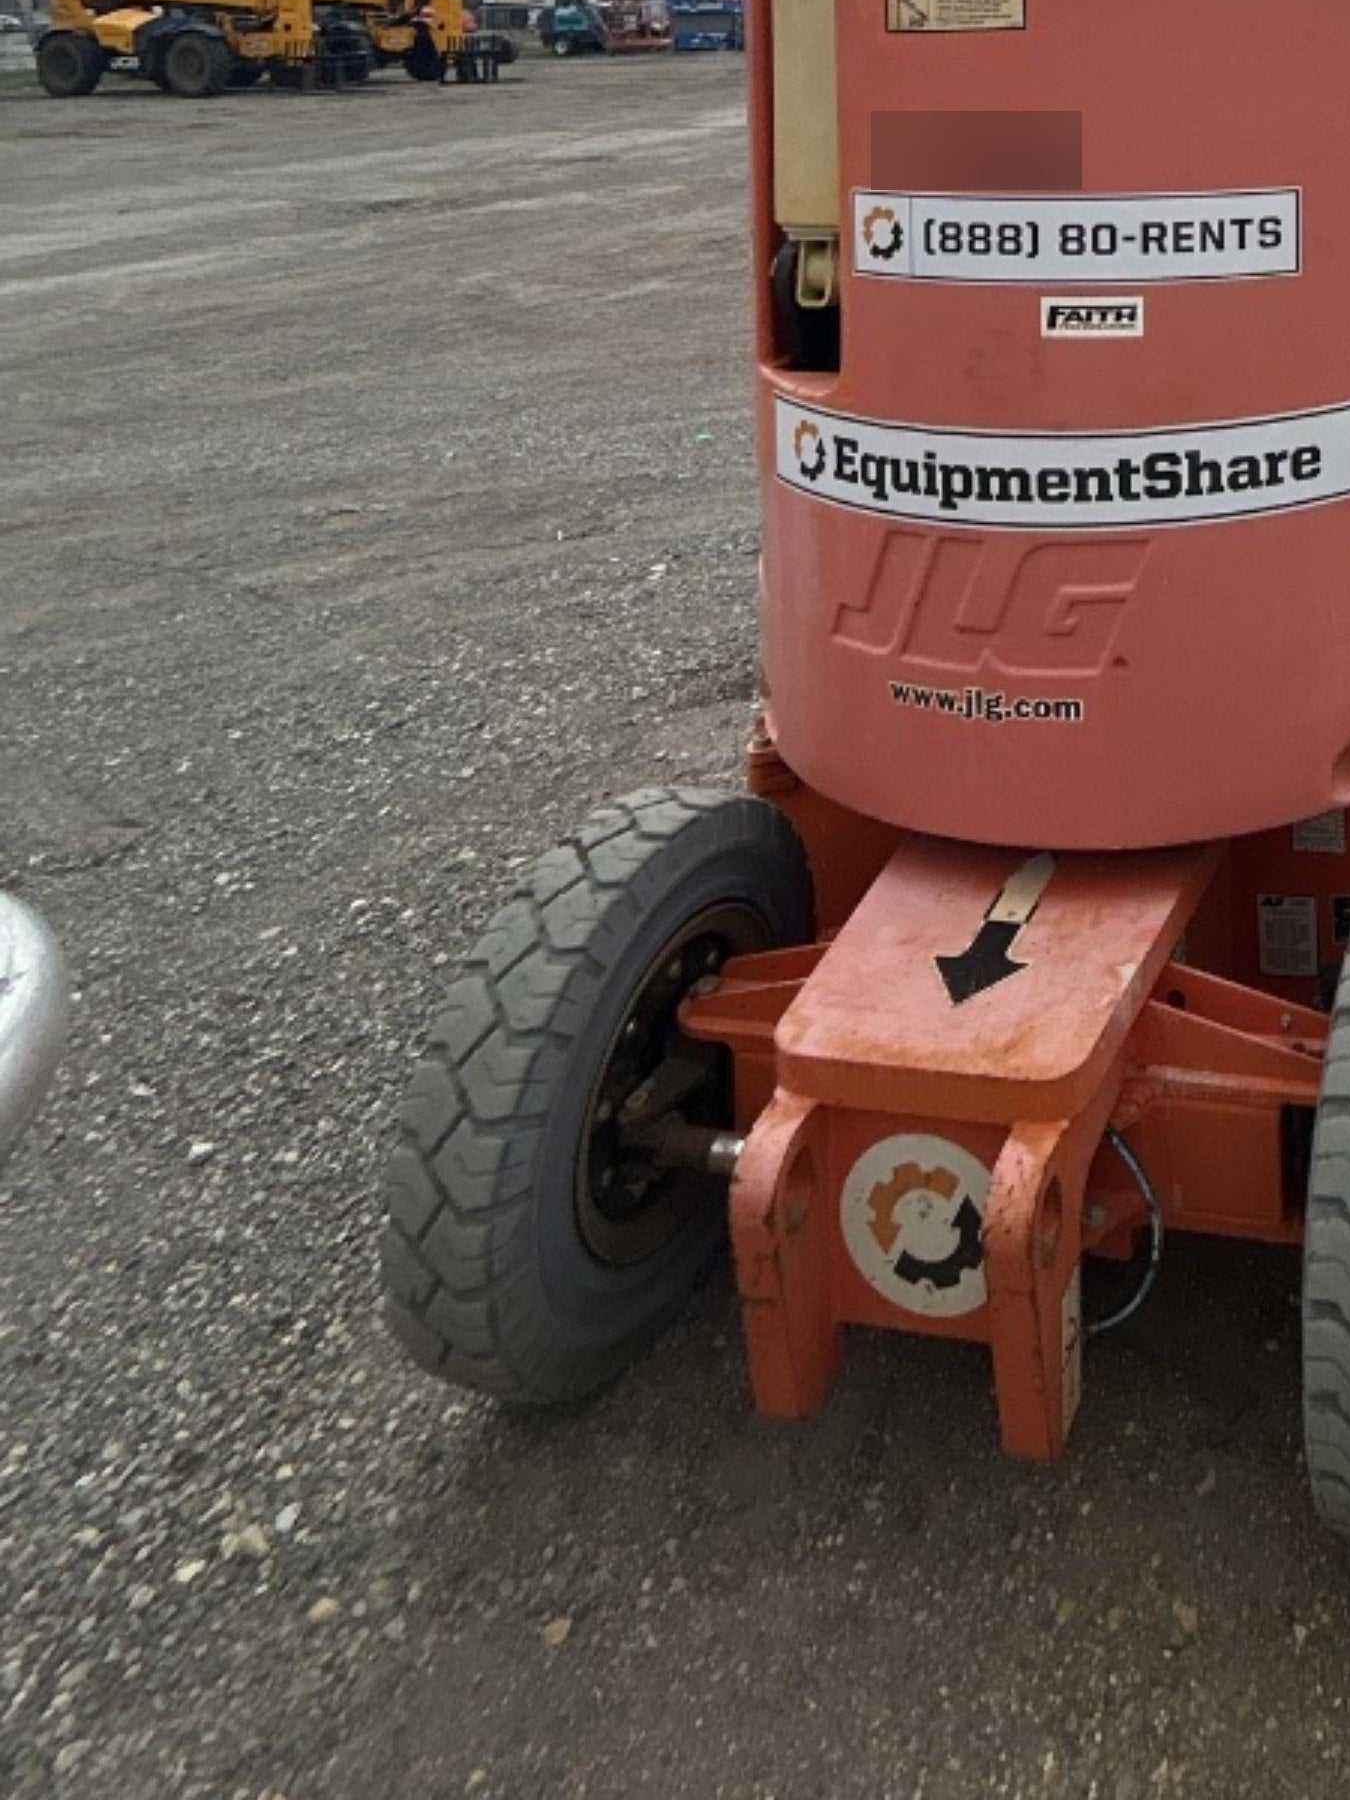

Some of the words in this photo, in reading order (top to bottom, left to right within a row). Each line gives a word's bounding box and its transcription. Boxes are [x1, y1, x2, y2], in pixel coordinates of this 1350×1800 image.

[923, 216, 1040, 259] (888)
[1060, 216, 1283, 257] 80-RENTS
[1047, 304, 1137, 330] FAITH
[833, 437, 1322, 510] EquipmentShare
[832, 530, 1154, 677] JLG
[890, 681, 1083, 722] www.jlg.com
